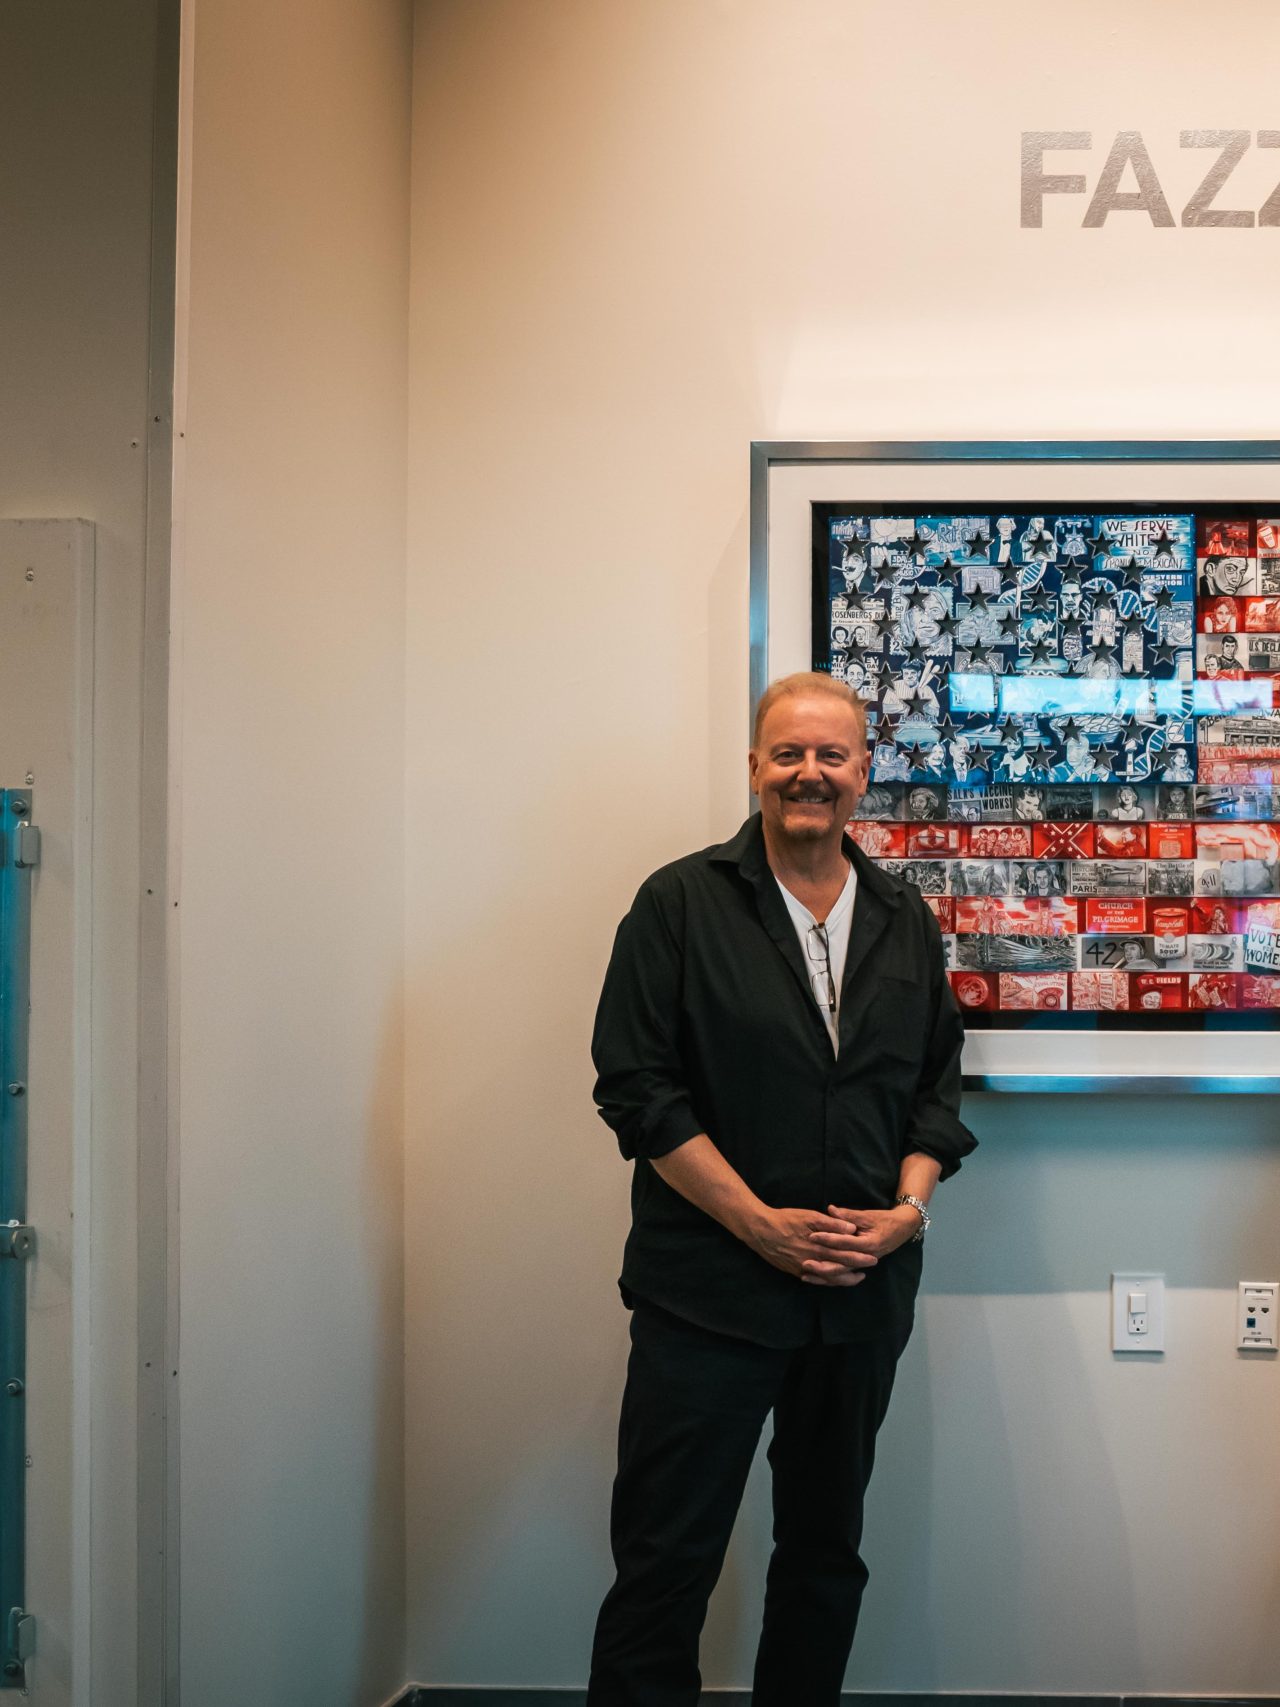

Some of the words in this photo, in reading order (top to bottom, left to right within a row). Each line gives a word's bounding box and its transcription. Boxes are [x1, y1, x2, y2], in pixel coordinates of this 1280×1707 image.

[1106, 520, 1128, 532] WE
[1134, 519, 1173, 532] SERVE
[832, 610, 872, 619] ROSENBERGS
[832, 655, 879, 664] HAEY
[948, 787, 975, 799] SALK'S
[979, 784, 1013, 798] VACCINE
[1072, 885, 1098, 893] PARIS
[1098, 902, 1134, 910] CHURCH
[1092, 915, 1138, 924] PILGRIMAGE
[1085, 942, 1118, 966] 42
[1156, 976, 1182, 985] FIELDS
